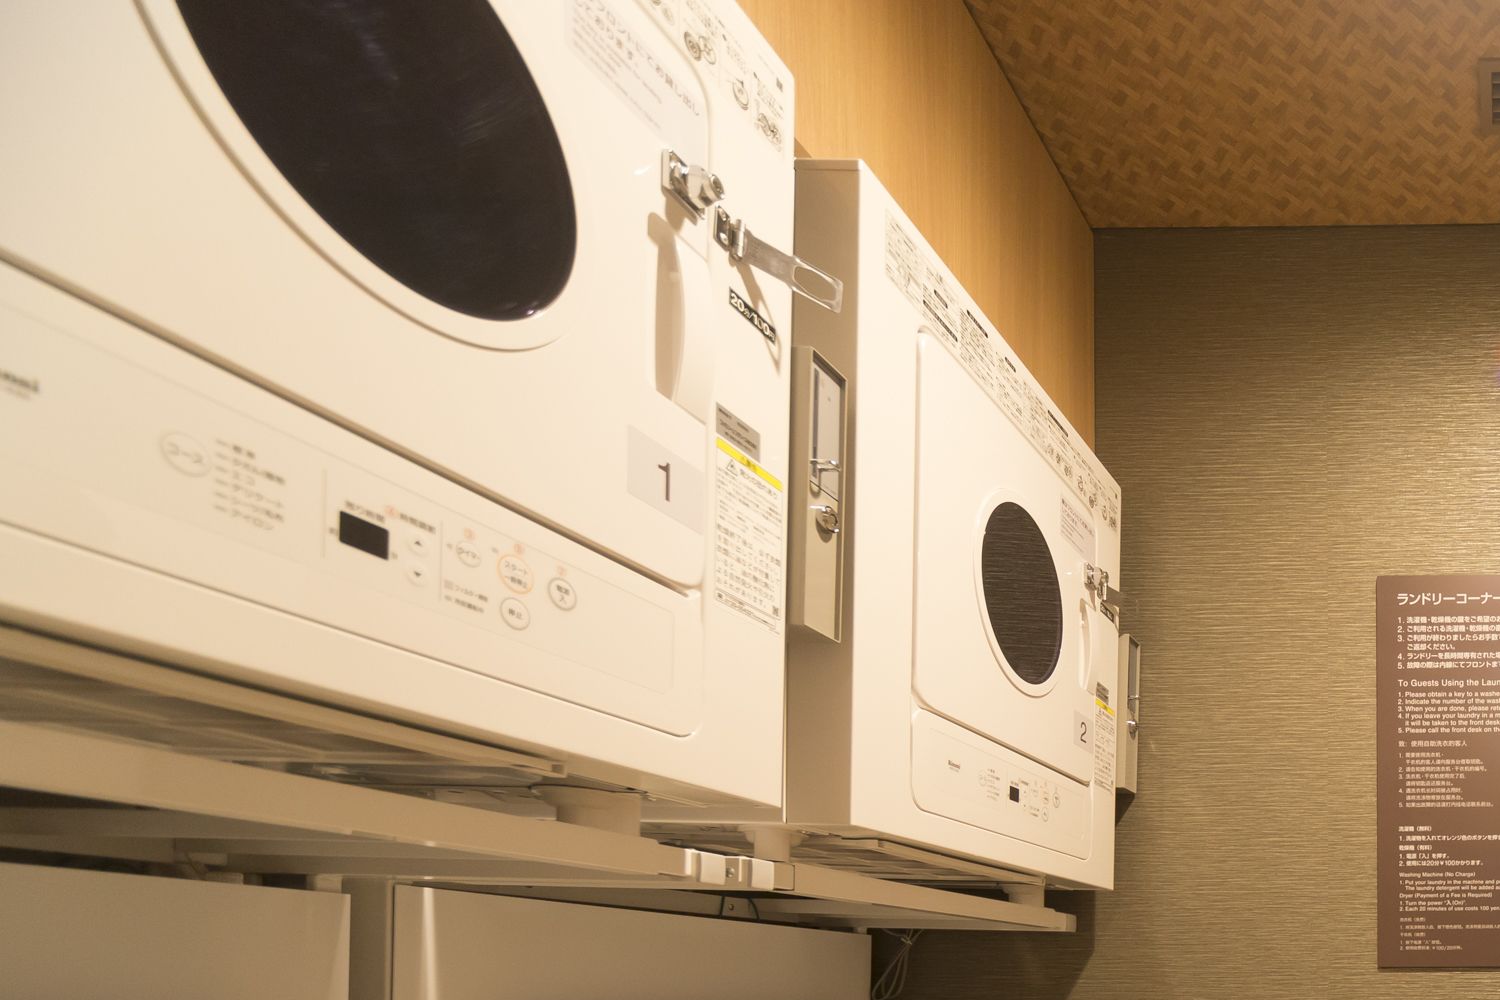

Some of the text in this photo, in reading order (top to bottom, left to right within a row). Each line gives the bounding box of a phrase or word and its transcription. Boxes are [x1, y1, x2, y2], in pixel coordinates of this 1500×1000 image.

[658, 462, 671, 502] 1
[1441, 679, 1464, 687] Using
[1080, 721, 1088, 743] 2
